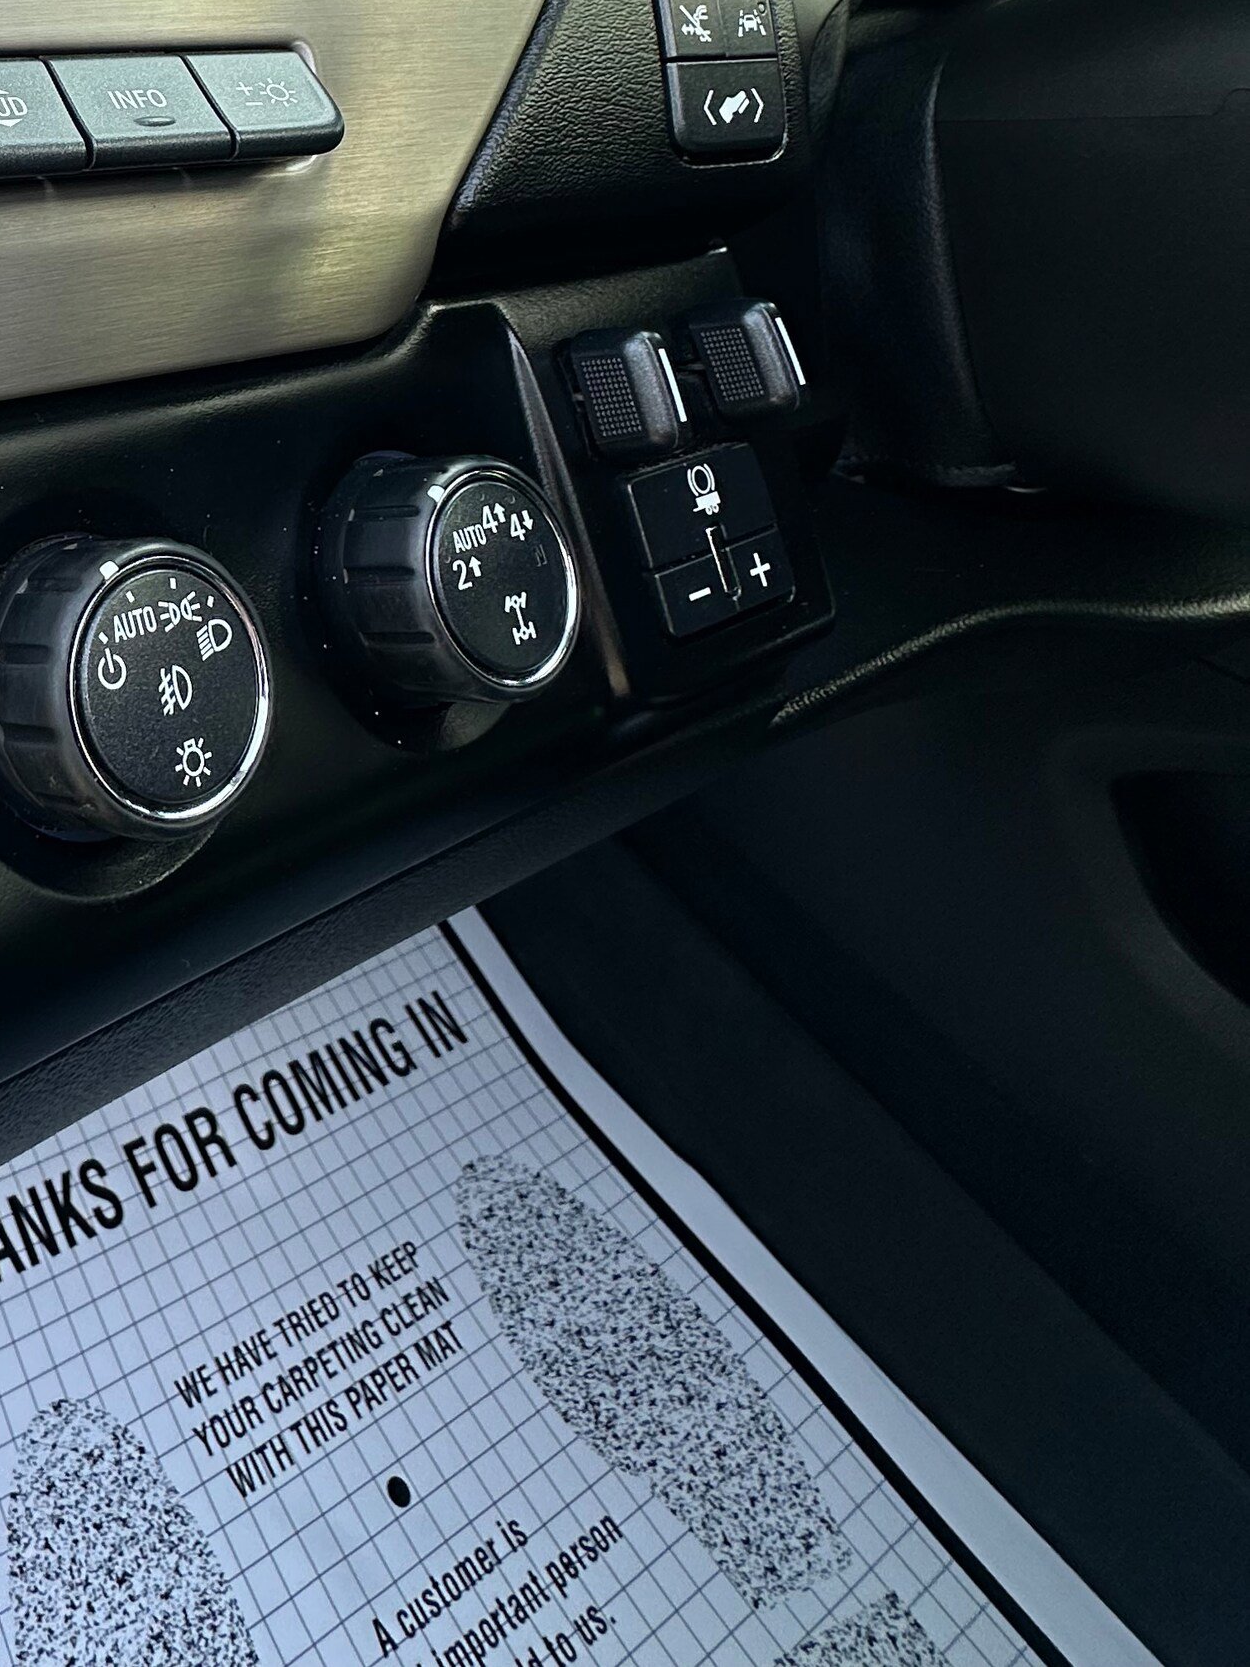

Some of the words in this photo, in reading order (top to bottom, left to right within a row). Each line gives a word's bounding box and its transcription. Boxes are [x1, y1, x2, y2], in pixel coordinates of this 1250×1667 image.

[107, 89, 168, 110] INFO
[452, 524, 487, 554] AUTO
[112, 606, 158, 643] AUTO
[122, 1106, 237, 1209] FOR
[232, 1016, 415, 1151] COMING
[405, 990, 469, 1058] IN
[174, 1365, 218, 1409] WE
[214, 1328, 278, 1386] HAVE
[272, 1291, 340, 1347] TRIED
[337, 1272, 372, 1307] TO
[368, 1241, 418, 1290] KEEP
[192, 1395, 265, 1457] YOUR
[261, 1319, 383, 1414] CARPETING
[380, 1276, 451, 1337] CLEAN
[225, 1434, 296, 1499] WITH
[290, 1399, 348, 1454] THIS
[344, 1353, 420, 1420] PAPER
[412, 1320, 464, 1371] MAT
[372, 1618, 399, 1658] A
[396, 1538, 502, 1639] customer
[497, 1519, 529, 1553] is
[544, 1515, 624, 1599] person
[573, 1606, 616, 1646] us.
